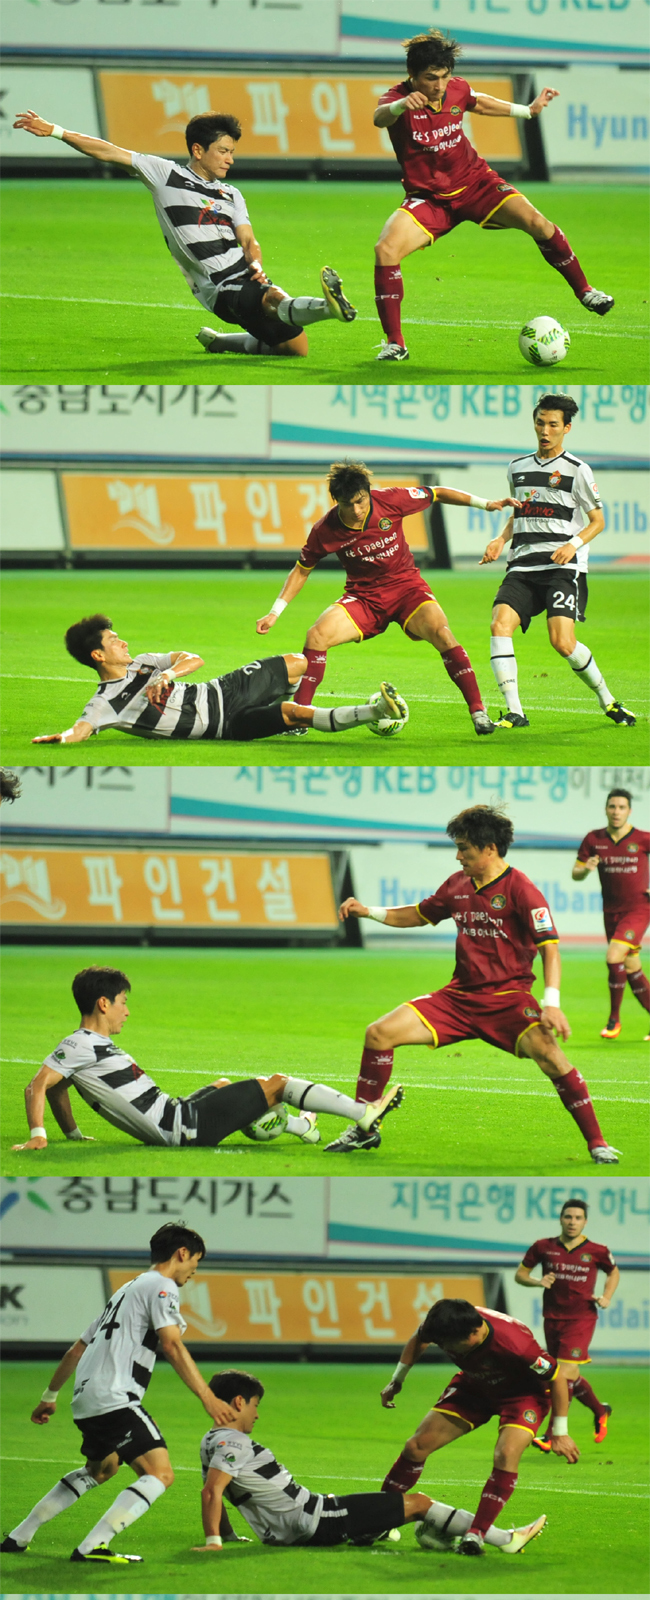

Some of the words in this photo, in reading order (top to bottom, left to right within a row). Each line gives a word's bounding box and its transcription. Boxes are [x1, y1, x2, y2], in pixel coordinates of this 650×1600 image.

[461, 385, 520, 417] KEB
[553, 591, 576, 611] 24
[82, 855, 297, 922] 파인건설
[58, 1177, 294, 1219] 충남도시가스
[391, 1181, 517, 1225] 지역은행
